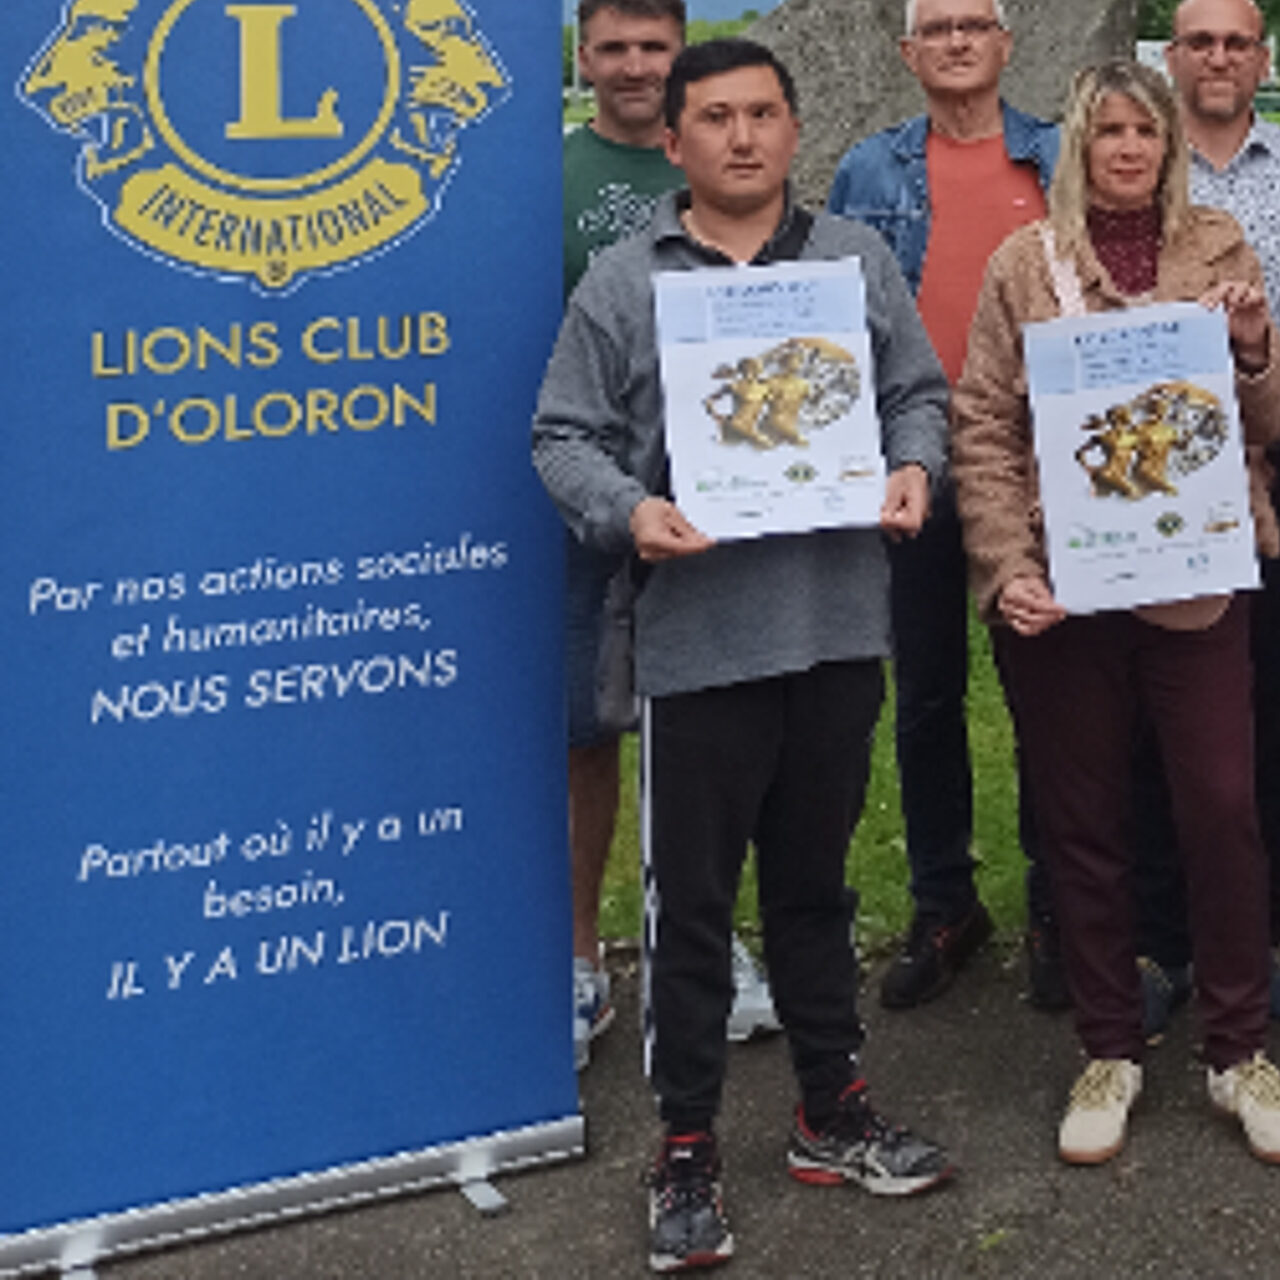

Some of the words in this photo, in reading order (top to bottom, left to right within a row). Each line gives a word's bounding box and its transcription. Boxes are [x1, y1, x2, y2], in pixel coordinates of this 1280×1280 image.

[225, 3, 344, 139] L
[137, 180, 408, 256] INTERNATIONAL
[91, 322, 281, 379] LIONS
[302, 312, 452, 364] CLUB
[106, 383, 437, 450] D'OLORON
[29, 577, 101, 614] Par
[113, 571, 187, 605] nos
[199, 556, 344, 597] actions
[357, 533, 508, 580] sociales
[111, 625, 151, 659] et
[163, 599, 432, 655] humanitaires,
[91, 675, 229, 724] NOUS
[245, 649, 458, 709] SERVONS
[77, 831, 232, 882] Partout
[240, 820, 293, 863] où
[305, 810, 335, 851] il
[341, 820, 366, 856] y
[378, 815, 402, 842] a
[418, 807, 464, 836] un
[202, 870, 345, 919] besoin,
[106, 962, 146, 1001] IL
[166, 951, 195, 989] Y
[204, 946, 238, 985] A
[255, 930, 326, 977] UN
[337, 911, 451, 965] LION
